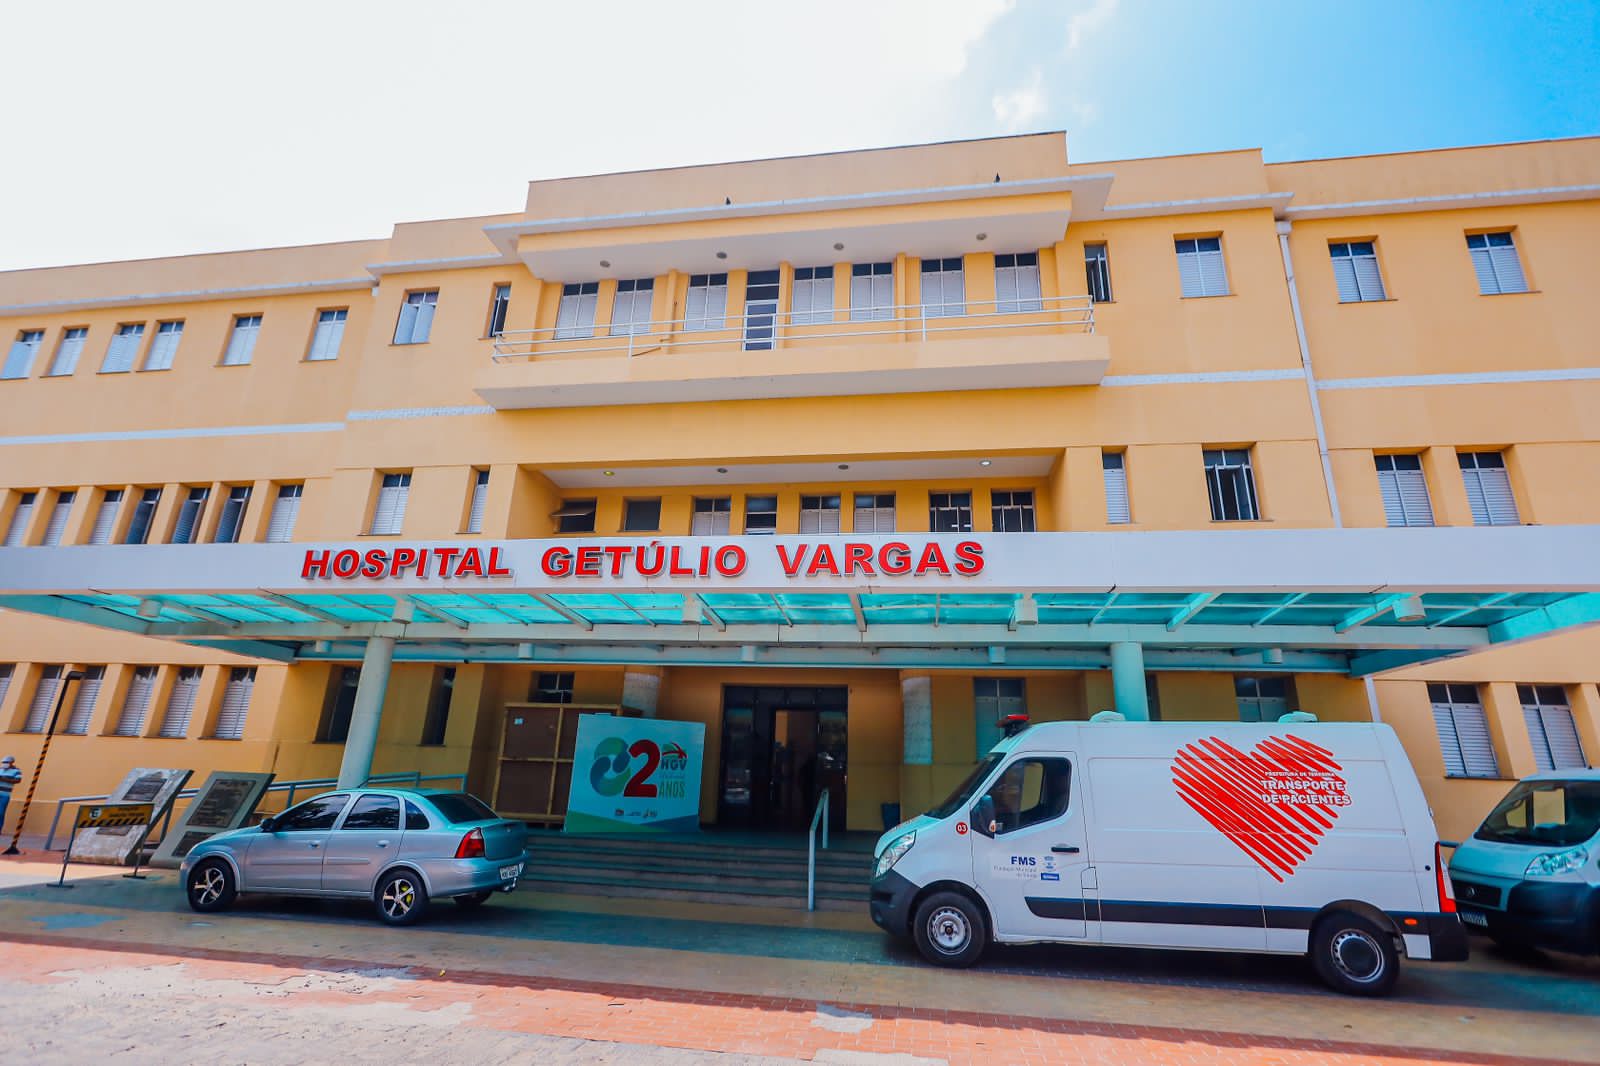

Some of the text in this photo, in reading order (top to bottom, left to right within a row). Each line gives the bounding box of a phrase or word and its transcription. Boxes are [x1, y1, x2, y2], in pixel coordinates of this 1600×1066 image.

[301, 541, 986, 578] HOSPITAL GETÚLIO VARGAS
[658, 780, 686, 799] ANOS
[1262, 780, 1345, 791] TRANSPORTE
[1263, 794, 1352, 805] DE PACIENTES
[957, 824, 967, 833] 03
[1010, 856, 1037, 866] FMS
